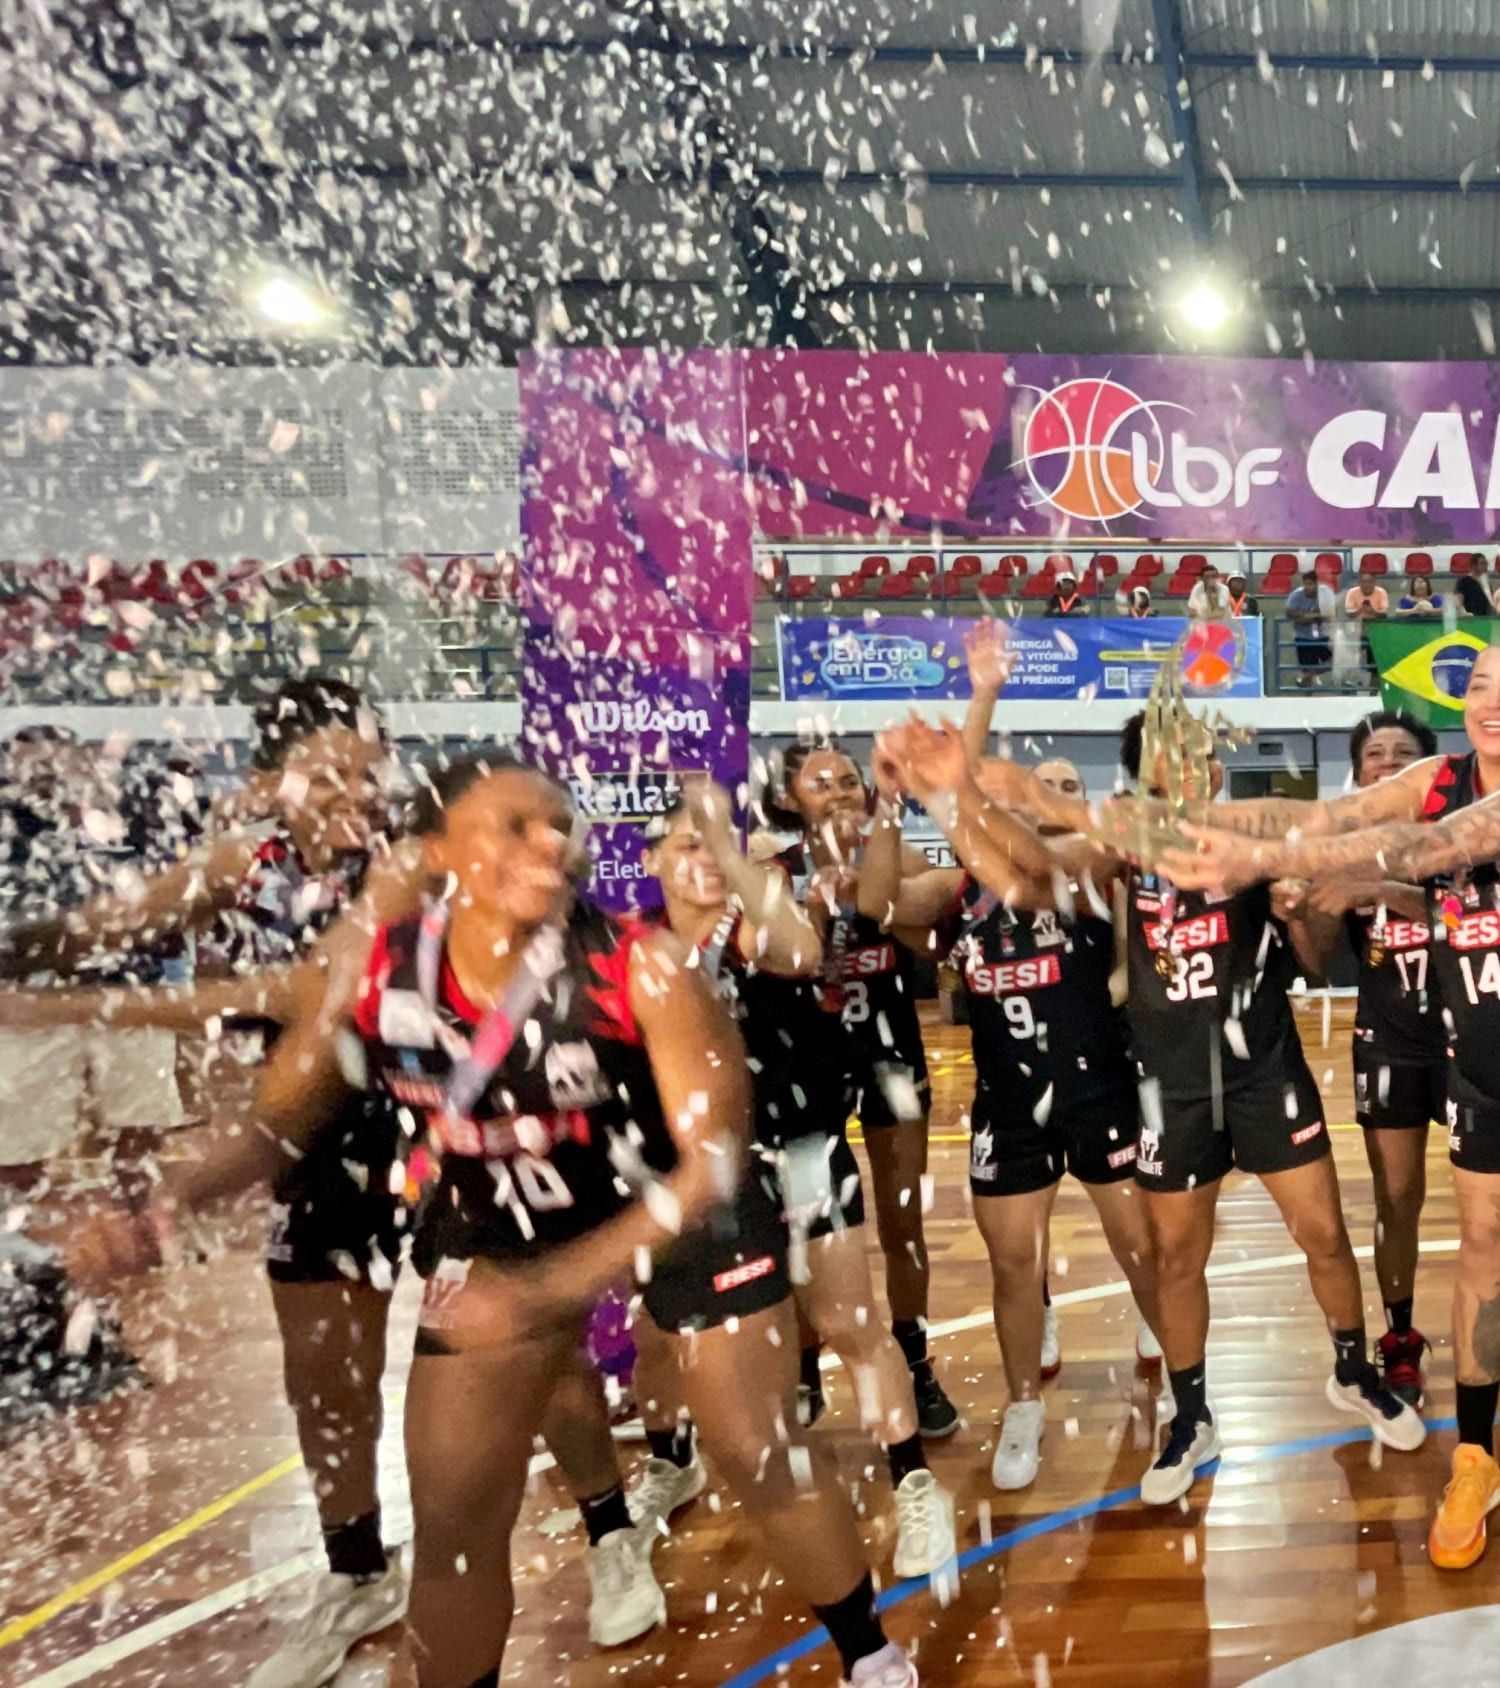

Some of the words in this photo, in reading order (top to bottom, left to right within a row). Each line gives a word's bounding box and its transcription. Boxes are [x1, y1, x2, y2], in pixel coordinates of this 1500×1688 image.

[1131, 431, 1284, 509] lbf
[1005, 640, 1053, 650] ENERGIA
[1027, 664, 1059, 673] PODE
[581, 700, 712, 733] Wilson
[569, 781, 681, 815] Renat
[1383, 921, 1431, 948] SES
[841, 947, 888, 975] ESI
[973, 959, 1051, 993] SESI
[1166, 951, 1218, 1002] 32
[1394, 948, 1430, 992] 17
[1003, 995, 1036, 1040] 9
[1114, 1147, 1137, 1167] FIE
[720, 1258, 772, 1291] FIESP
